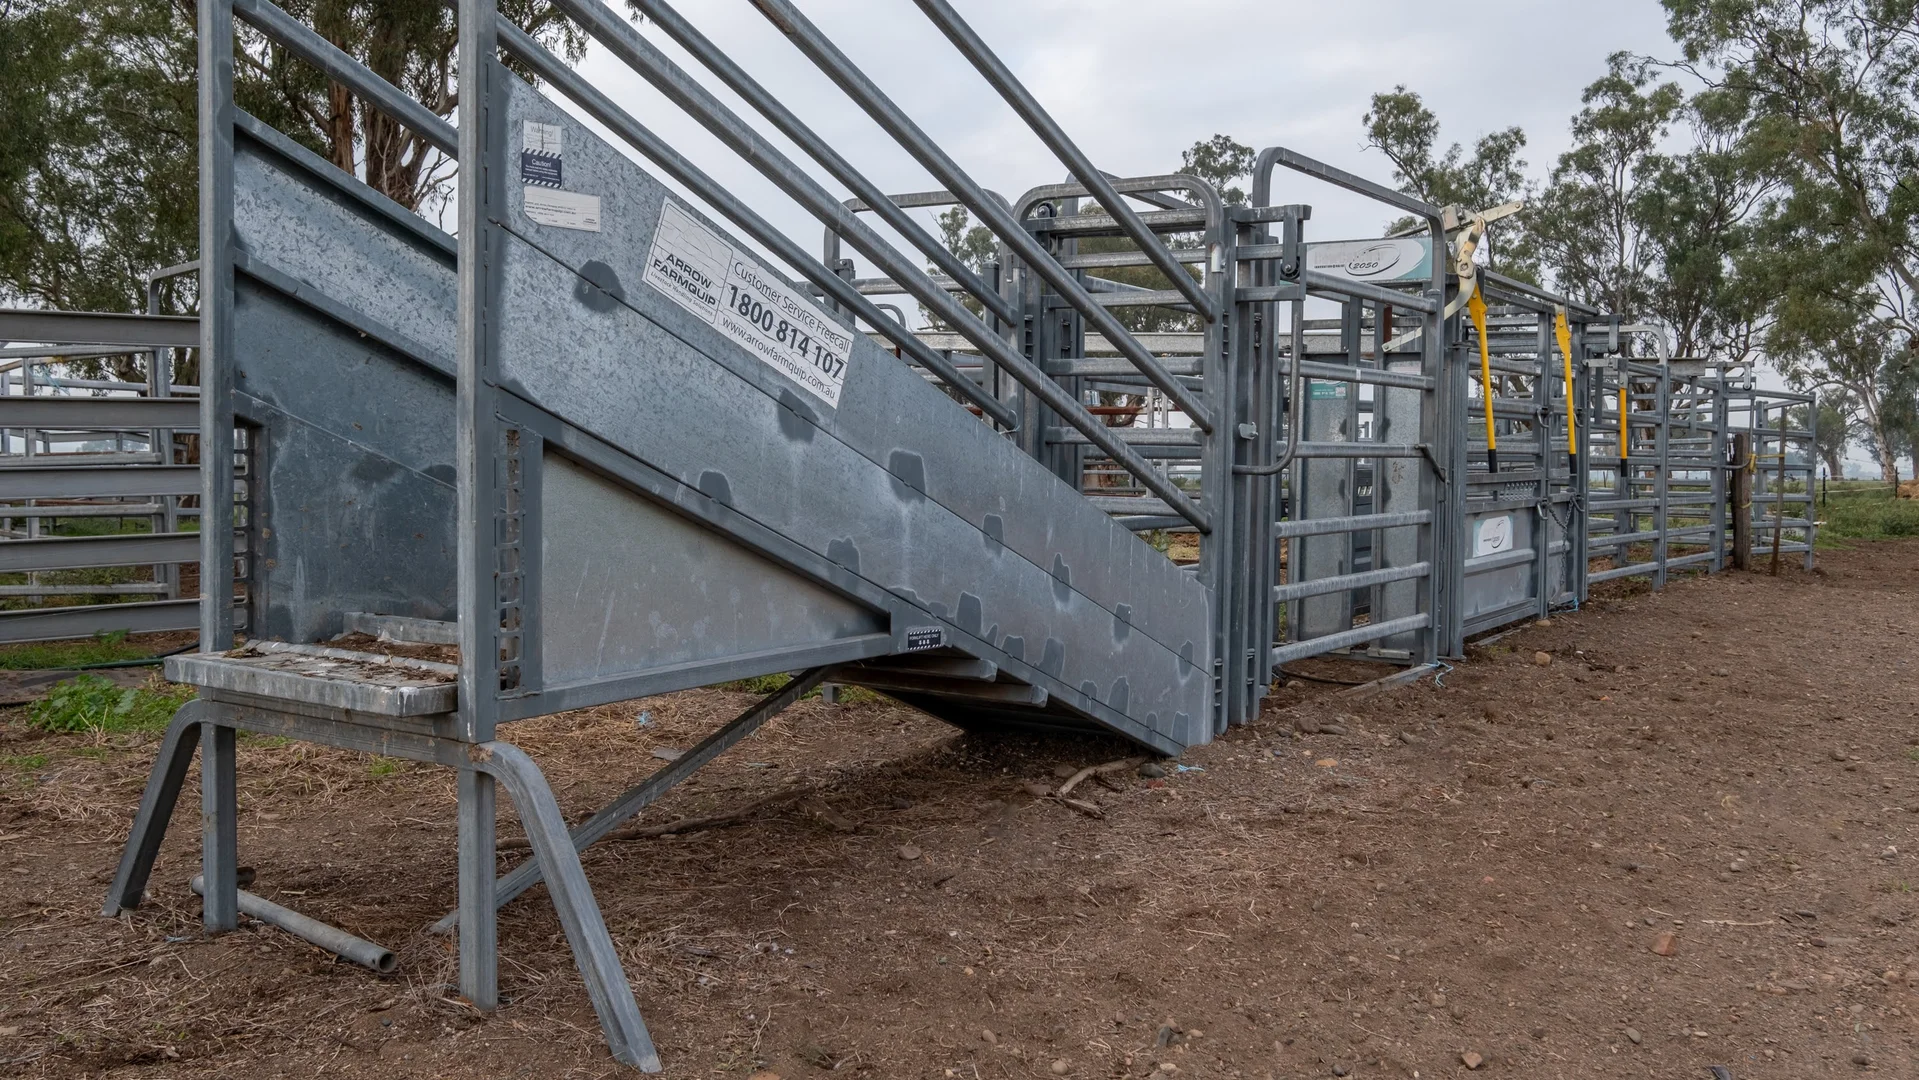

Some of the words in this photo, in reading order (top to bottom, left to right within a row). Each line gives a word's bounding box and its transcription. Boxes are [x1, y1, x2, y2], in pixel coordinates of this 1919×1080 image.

[531, 158, 552, 168] Caution!
[650, 271, 672, 288] Livestock
[672, 285, 693, 303] Handling
[692, 299, 713, 316] Solutions
[653, 259, 716, 305] FARMQUIP
[666, 254, 711, 288] ARROW
[734, 262, 781, 303] Customer
[782, 296, 815, 328] Service
[816, 320, 850, 353] Freecall
[729, 285, 773, 332] 1800
[776, 320, 810, 357] 814
[814, 345, 844, 379] 107
[722, 317, 836, 399] www.arrowfarmquip.com.au
